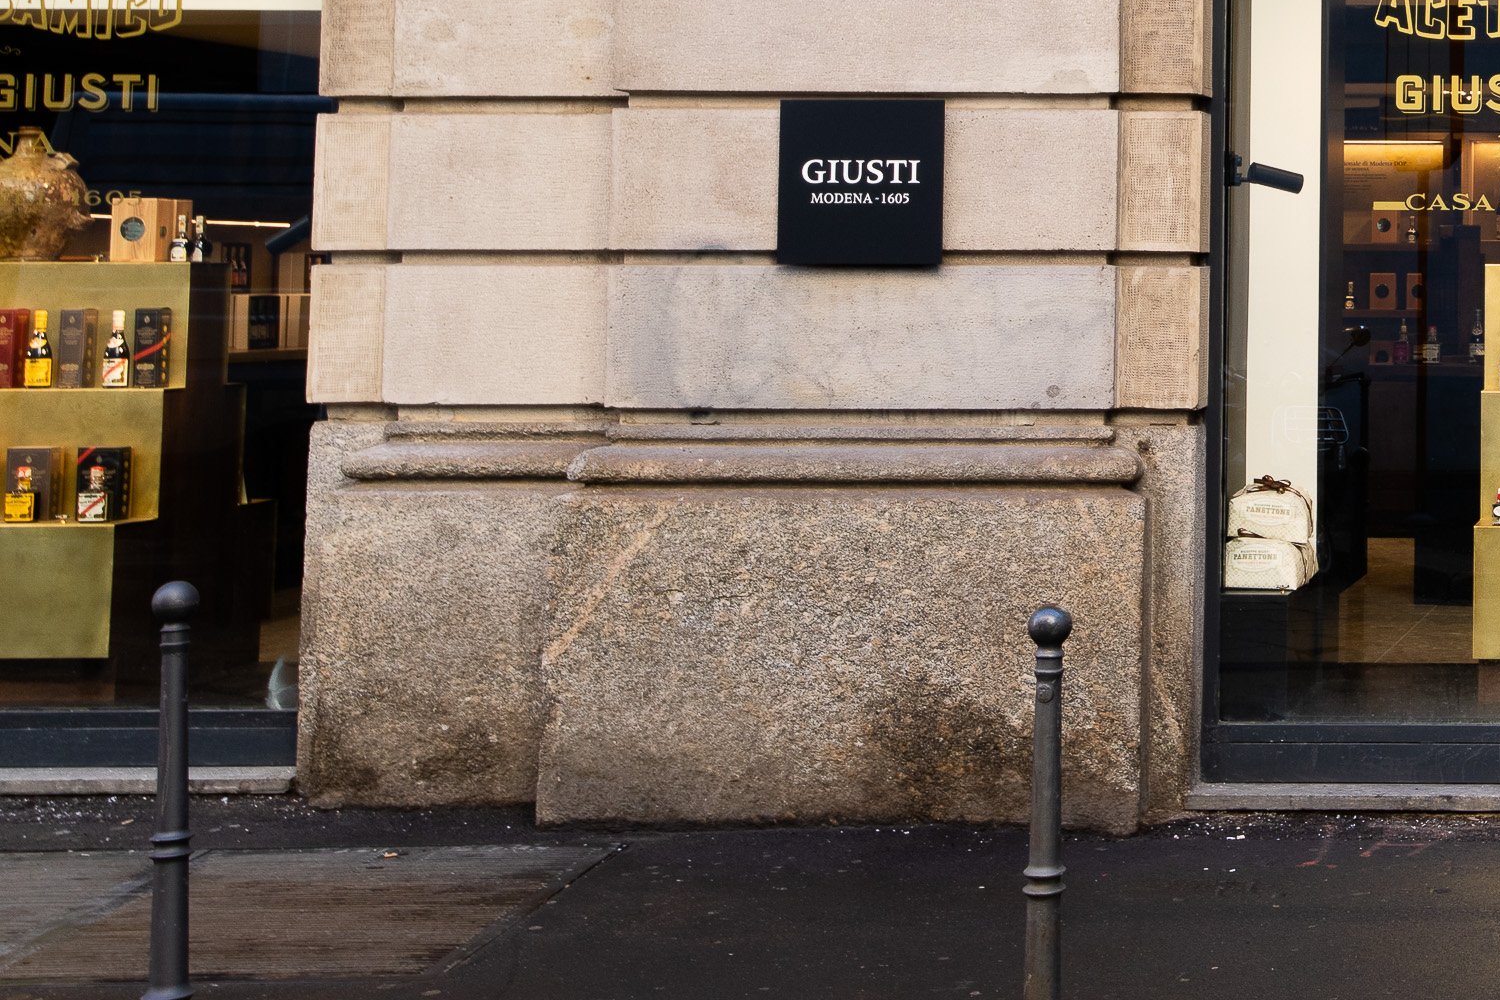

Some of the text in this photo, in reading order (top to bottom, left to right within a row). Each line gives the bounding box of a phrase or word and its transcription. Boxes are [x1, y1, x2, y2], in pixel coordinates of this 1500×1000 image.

[801, 158, 921, 184] GIUSTI
[1405, 192, 1496, 212] CASA
[1246, 506, 1290, 516] PANETTONE
